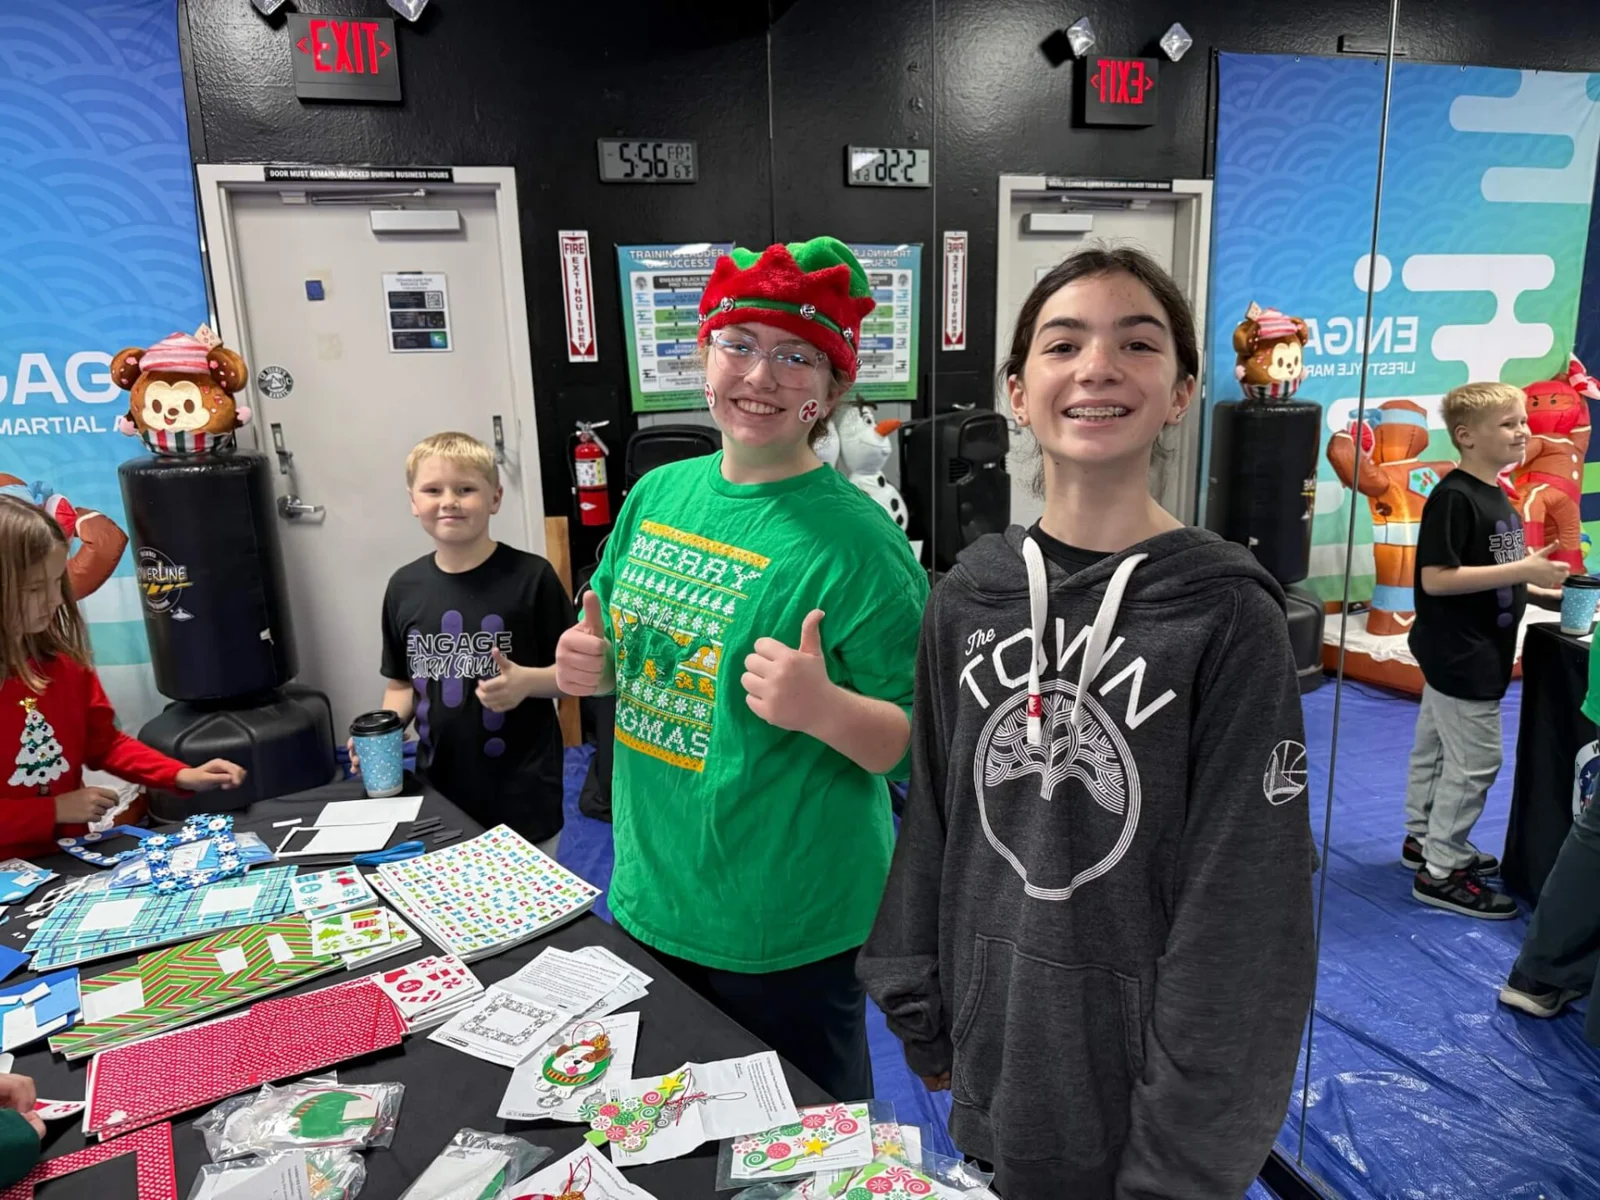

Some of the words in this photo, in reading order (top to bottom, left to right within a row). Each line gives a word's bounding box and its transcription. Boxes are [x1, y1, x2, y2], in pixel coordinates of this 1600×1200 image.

[309, 19, 379, 75] EXIT
[619, 143, 668, 178] 5:56
[668, 145, 690, 160] FRI
[270, 169, 289, 177] DOOR
[290, 170, 308, 178] MUST
[309, 170, 336, 178] REMAIN
[337, 171, 369, 179] UNLOCKED
[371, 171, 394, 179] DURING
[396, 171, 426, 179] BUSINESS
[428, 171, 449, 179] HOURS
[564, 243, 585, 255] FIRE
[663, 258, 710, 269] SUCCESS
[572, 257, 586, 349] EXTINGUISHER
[629, 533, 762, 591] MERRY
[406, 631, 513, 657] ENGAGE
[965, 628, 996, 656] The
[410, 654, 453, 681] STORM
[959, 617, 1177, 731] TOWN
